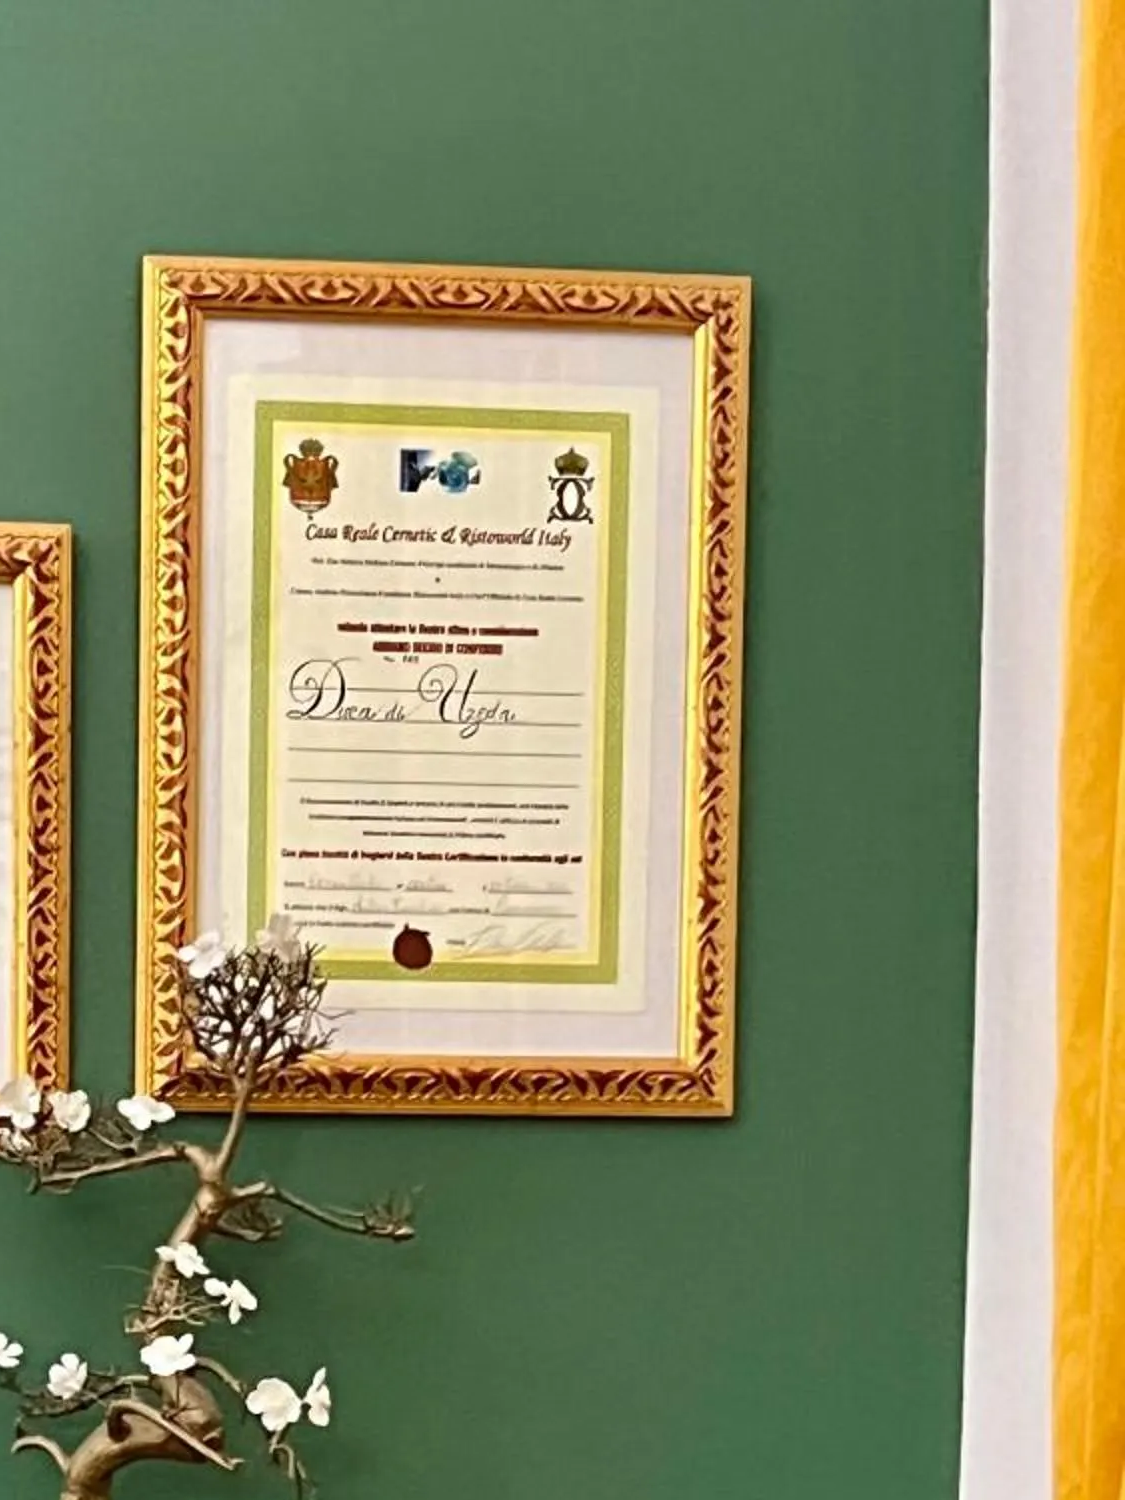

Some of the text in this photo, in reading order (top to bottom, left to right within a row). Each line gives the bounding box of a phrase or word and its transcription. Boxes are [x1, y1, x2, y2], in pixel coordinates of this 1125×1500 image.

[305, 523, 338, 541] Casa
[342, 522, 380, 543] Reale
[537, 528, 572, 553] Italy
